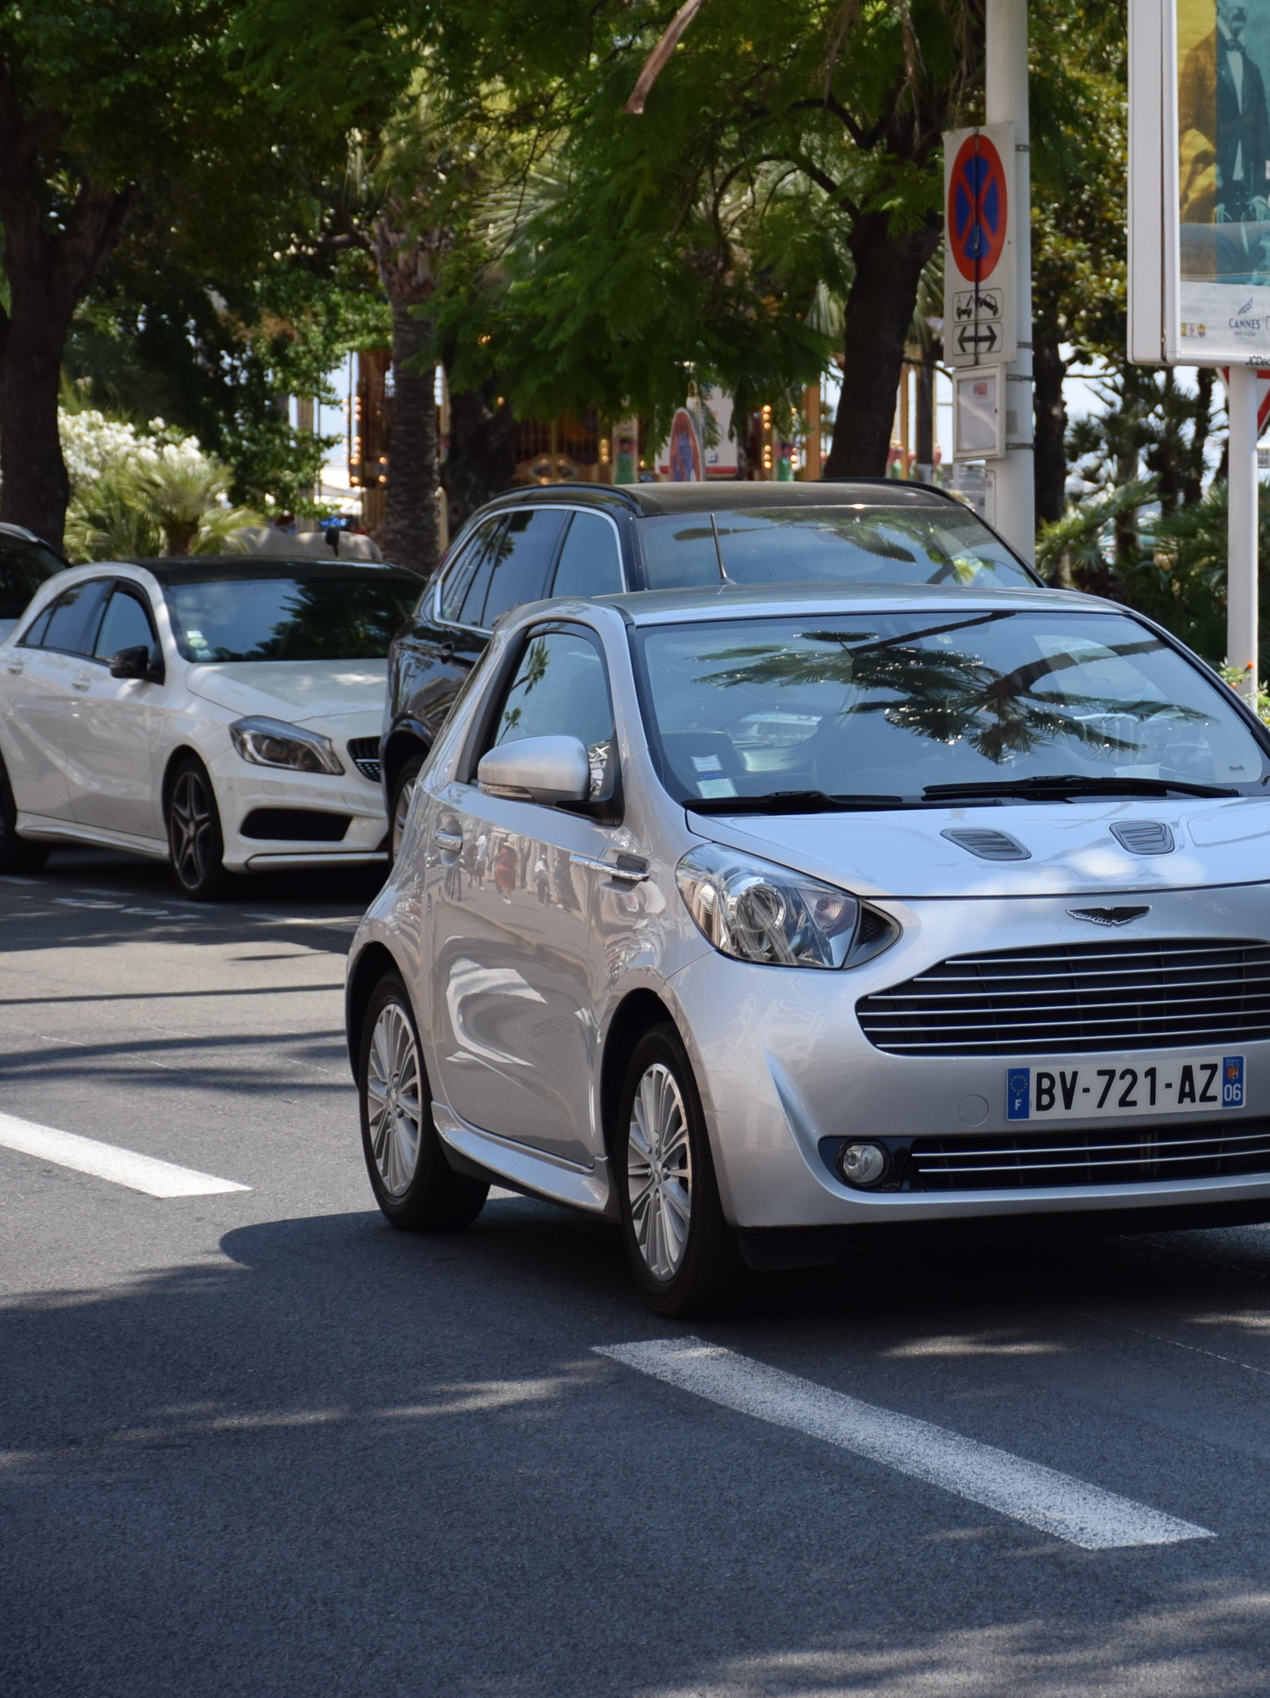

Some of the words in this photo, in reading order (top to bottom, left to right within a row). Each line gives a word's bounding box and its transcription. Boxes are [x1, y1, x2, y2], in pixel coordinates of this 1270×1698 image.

[1228, 318, 1261, 330] CANNES
[1014, 1099, 1022, 1110] F
[1036, 1063, 1219, 1111] BV-721-AZ
[1224, 1083, 1242, 1101] 06
